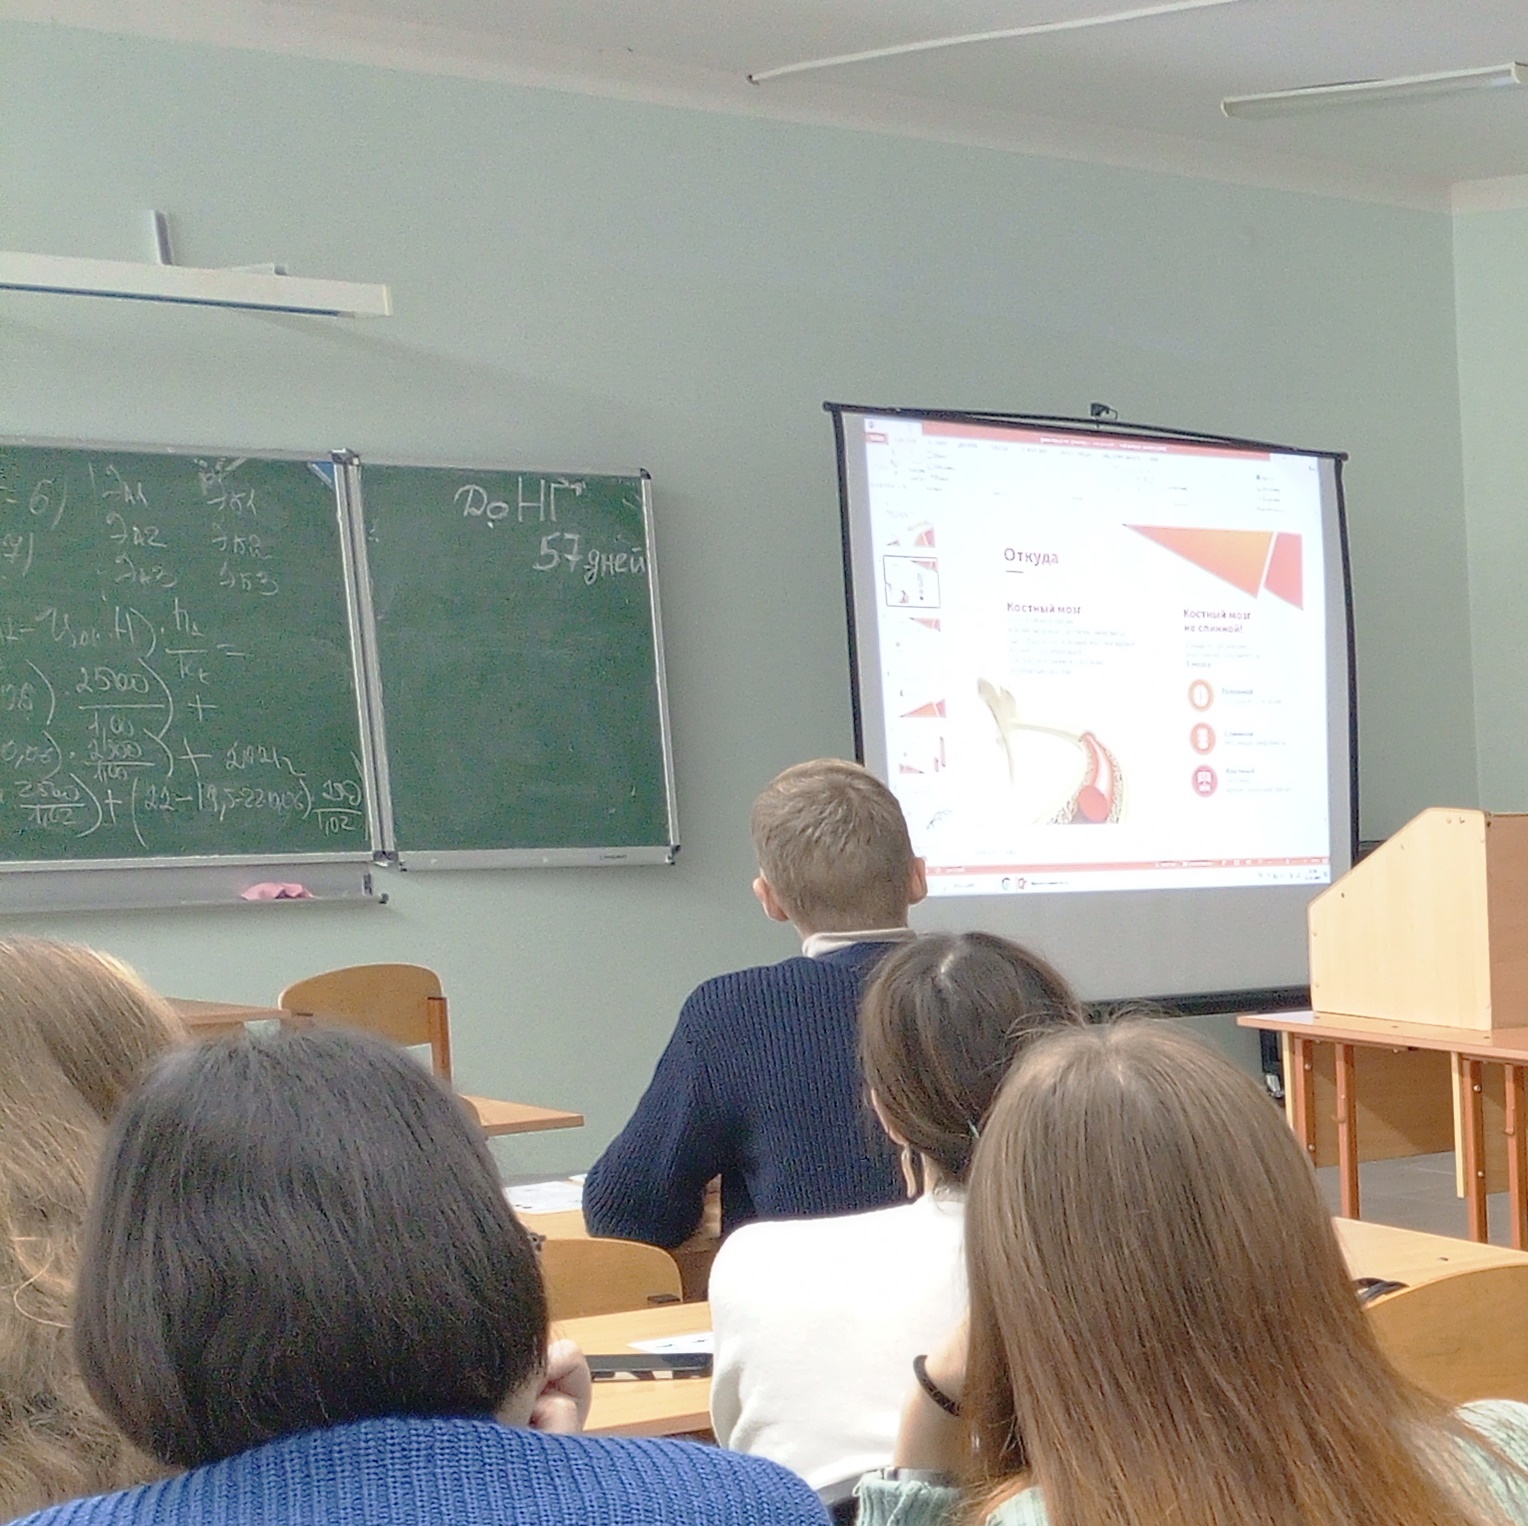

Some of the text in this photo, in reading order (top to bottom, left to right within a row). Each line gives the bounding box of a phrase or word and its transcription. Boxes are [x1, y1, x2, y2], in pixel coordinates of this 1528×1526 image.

[533, 532, 646, 585] 57 дней
[1004, 548, 1059, 566] Откуда
[1007, 602, 1081, 615] Костный мозг
[1183, 609, 1251, 620] Костный мозг
